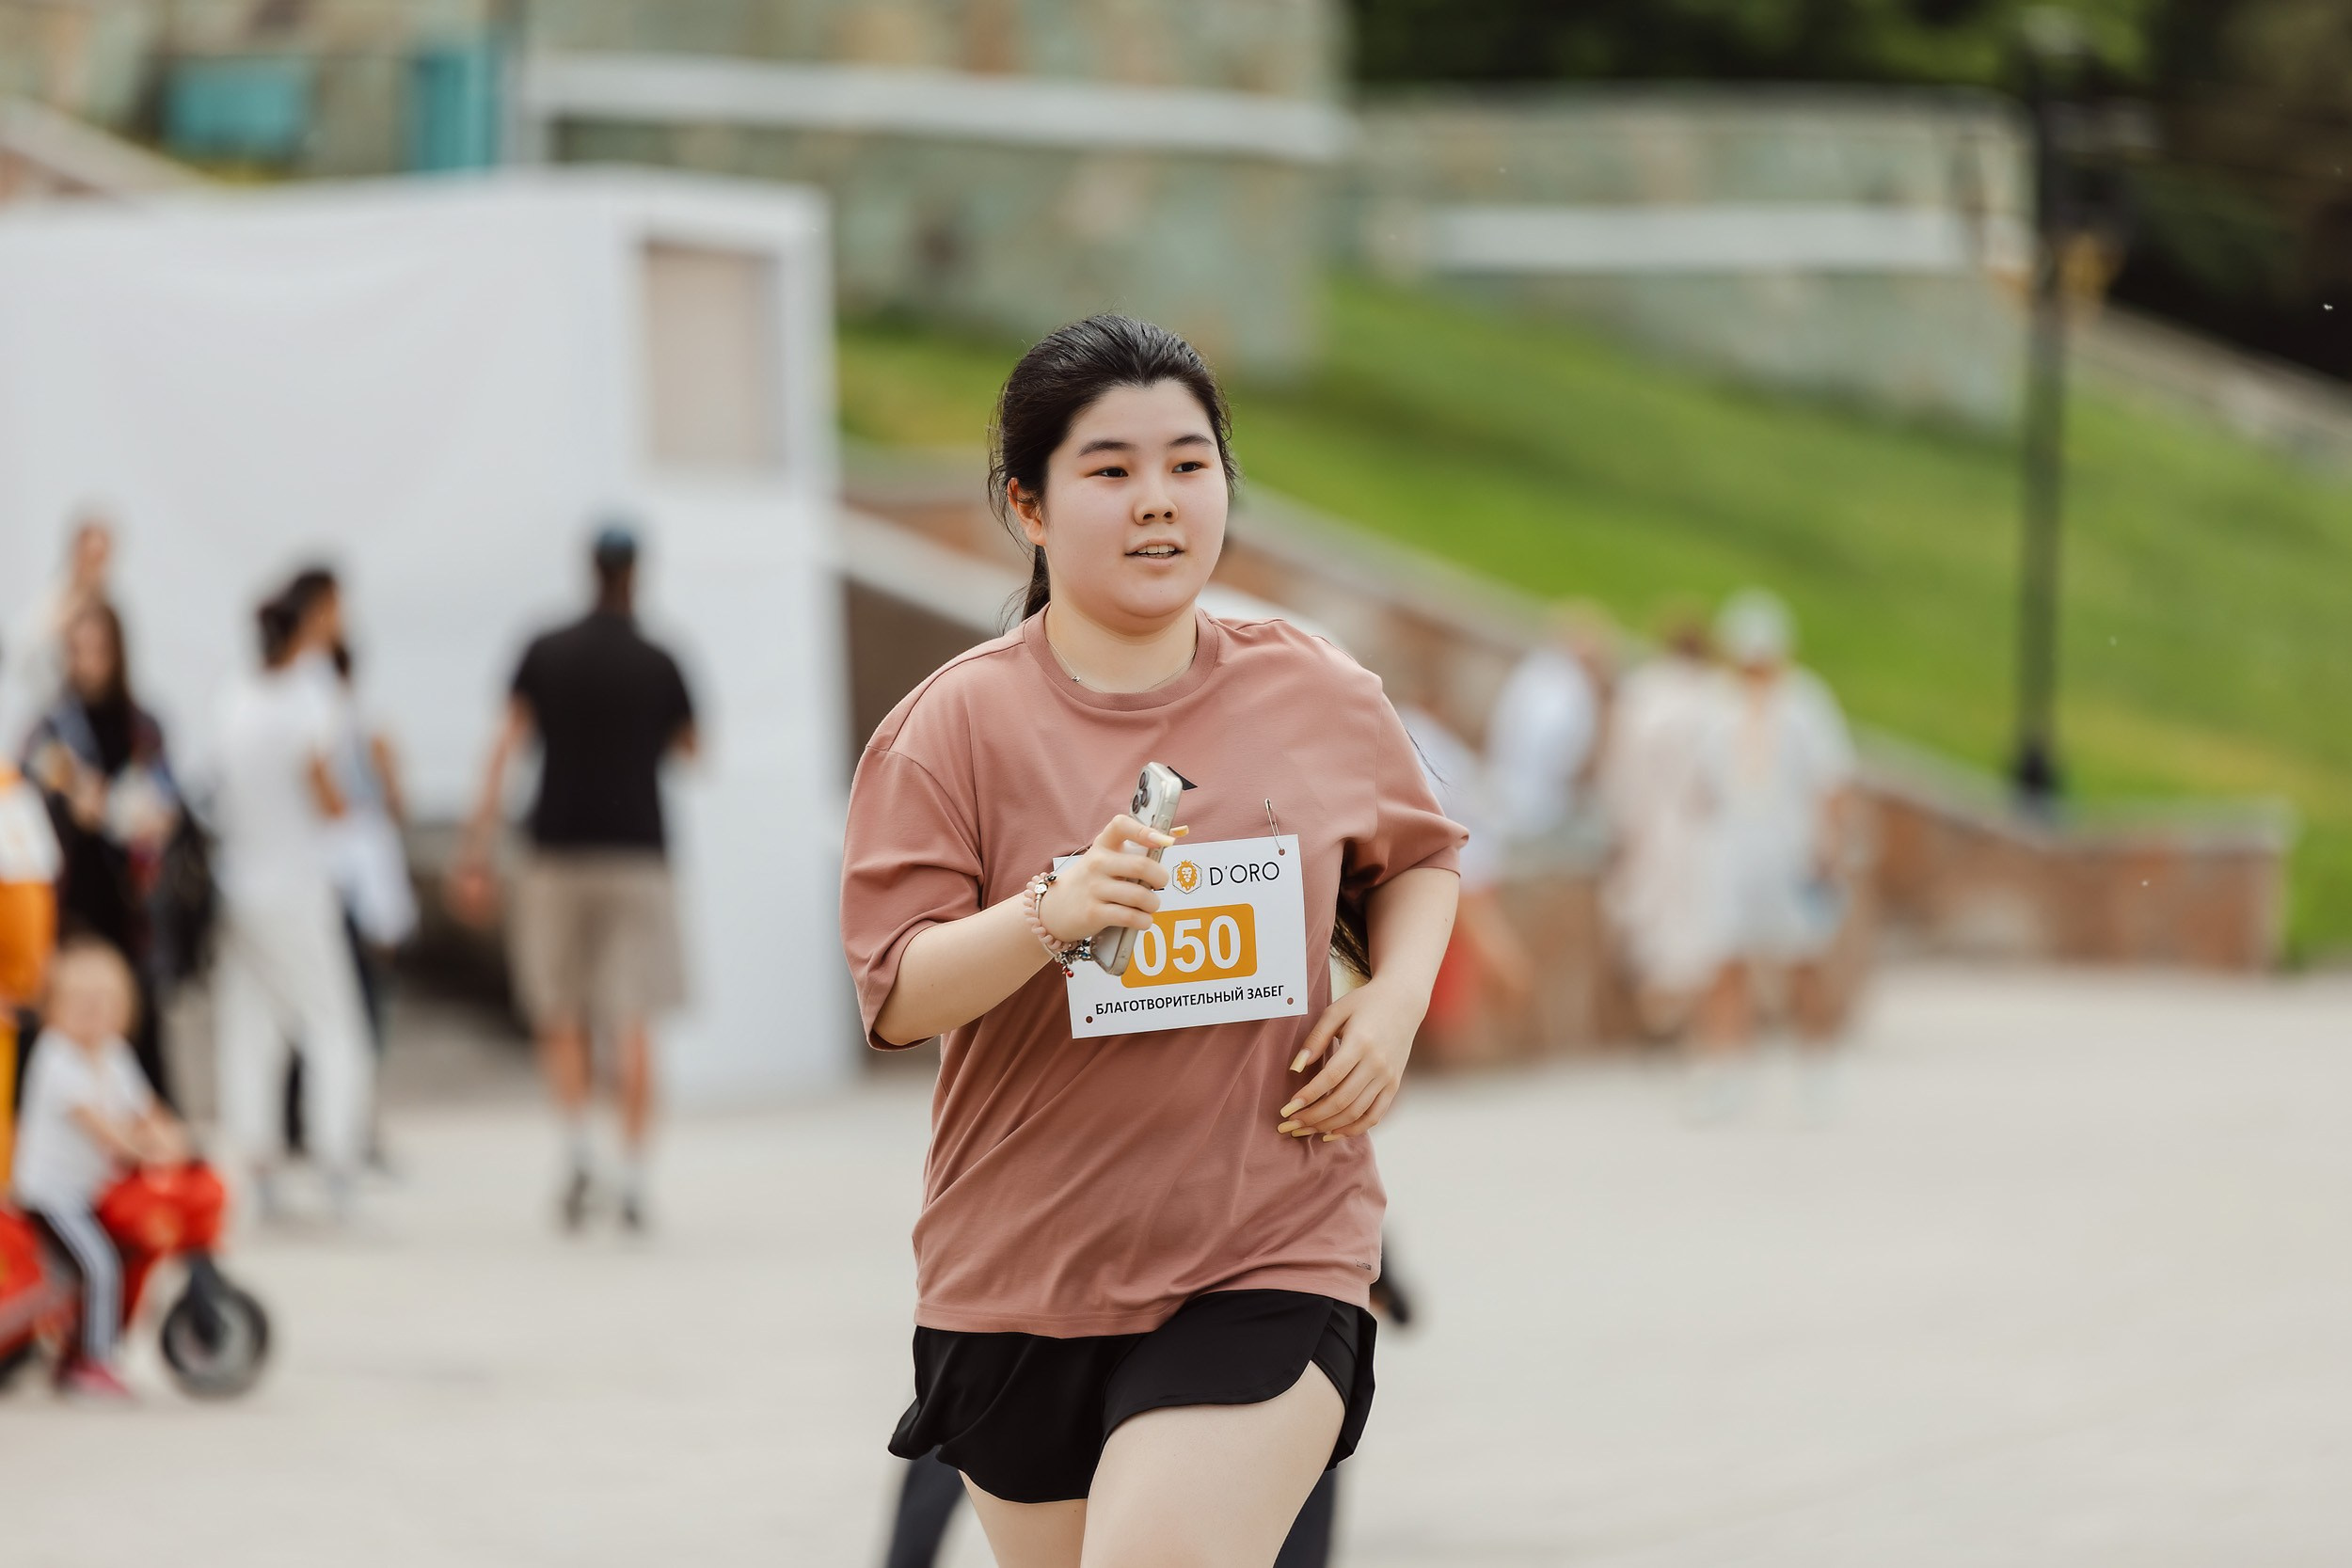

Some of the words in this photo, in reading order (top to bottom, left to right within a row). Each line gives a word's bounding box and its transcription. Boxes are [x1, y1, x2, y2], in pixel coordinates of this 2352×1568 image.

[1209, 862, 1279, 886] D'ORO
[1133, 915, 1241, 976] 050
[1095, 987, 1244, 1015] БЛАГОТВОРИТЕЛЬНЫЙ
[1247, 985, 1285, 1000] ЗАБЕГ
